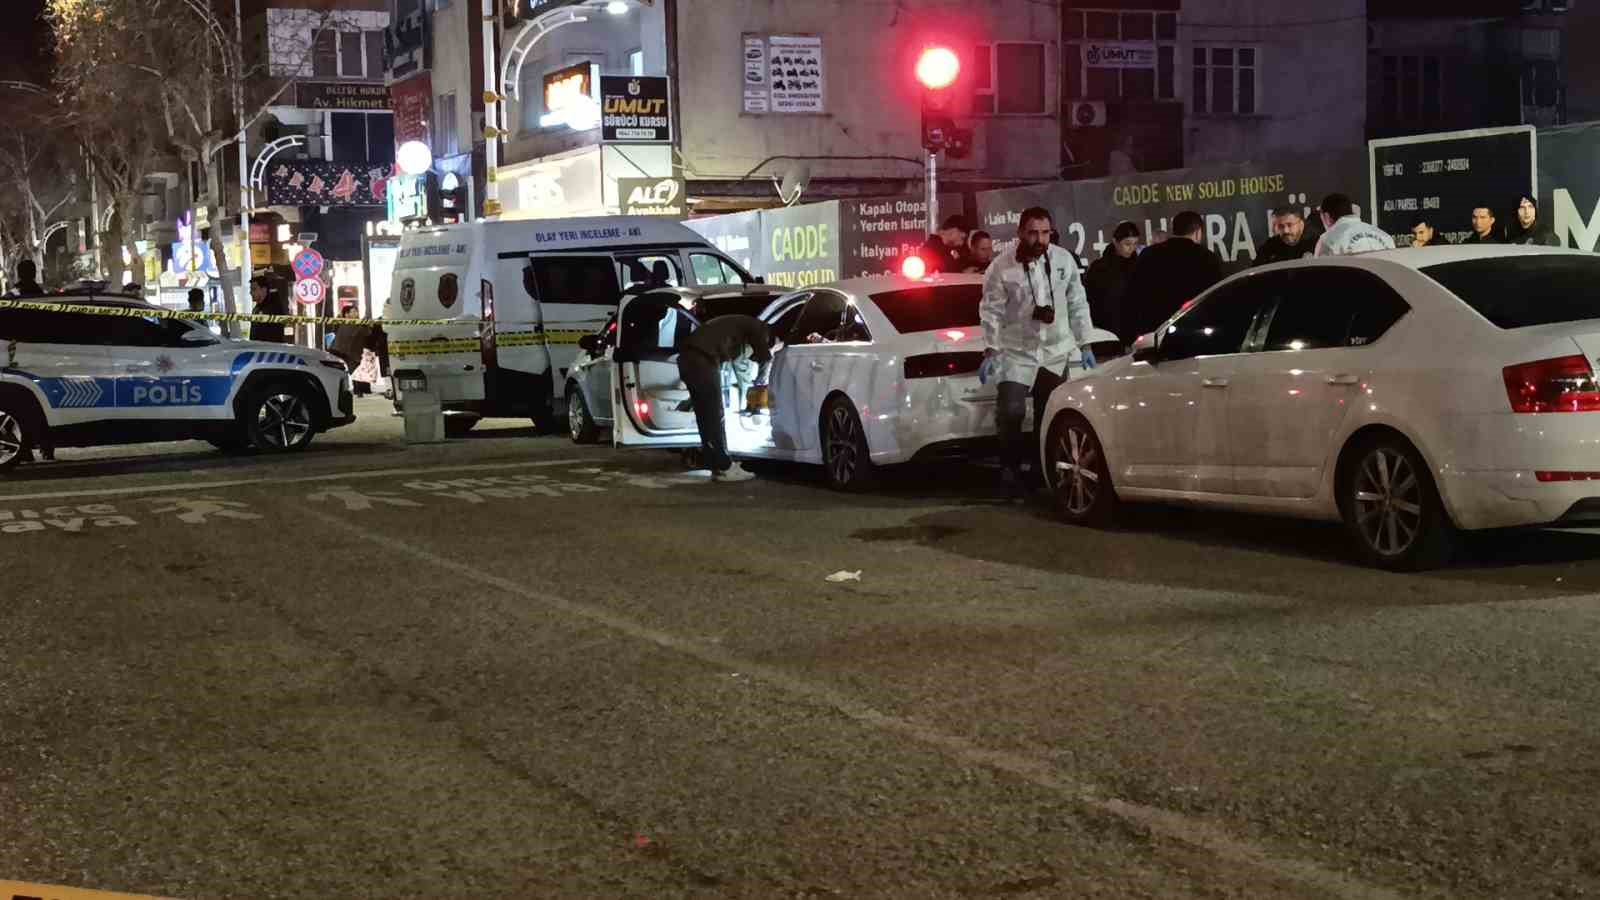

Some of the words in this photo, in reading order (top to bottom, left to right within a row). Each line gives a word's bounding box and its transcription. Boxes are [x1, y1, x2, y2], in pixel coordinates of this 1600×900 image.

[335, 96, 383, 108] Hikmet
[604, 98, 665, 113] UMUT
[1113, 183, 1160, 206] CADDE
[1166, 184, 1194, 201] NEW
[1199, 178, 1236, 199] SOLID
[1240, 174, 1284, 194] HOUSE
[860, 202, 893, 217] Kapalı
[896, 200, 928, 215] Otopa
[860, 219, 898, 232] Yerden
[901, 217, 928, 231] Isıtm
[771, 223, 829, 262] CADDE
[860, 242, 899, 260] İtalyan
[902, 243, 925, 256] Par
[768, 271, 795, 286] NEW
[797, 268, 835, 286] SOLID
[301, 283, 320, 297] 30
